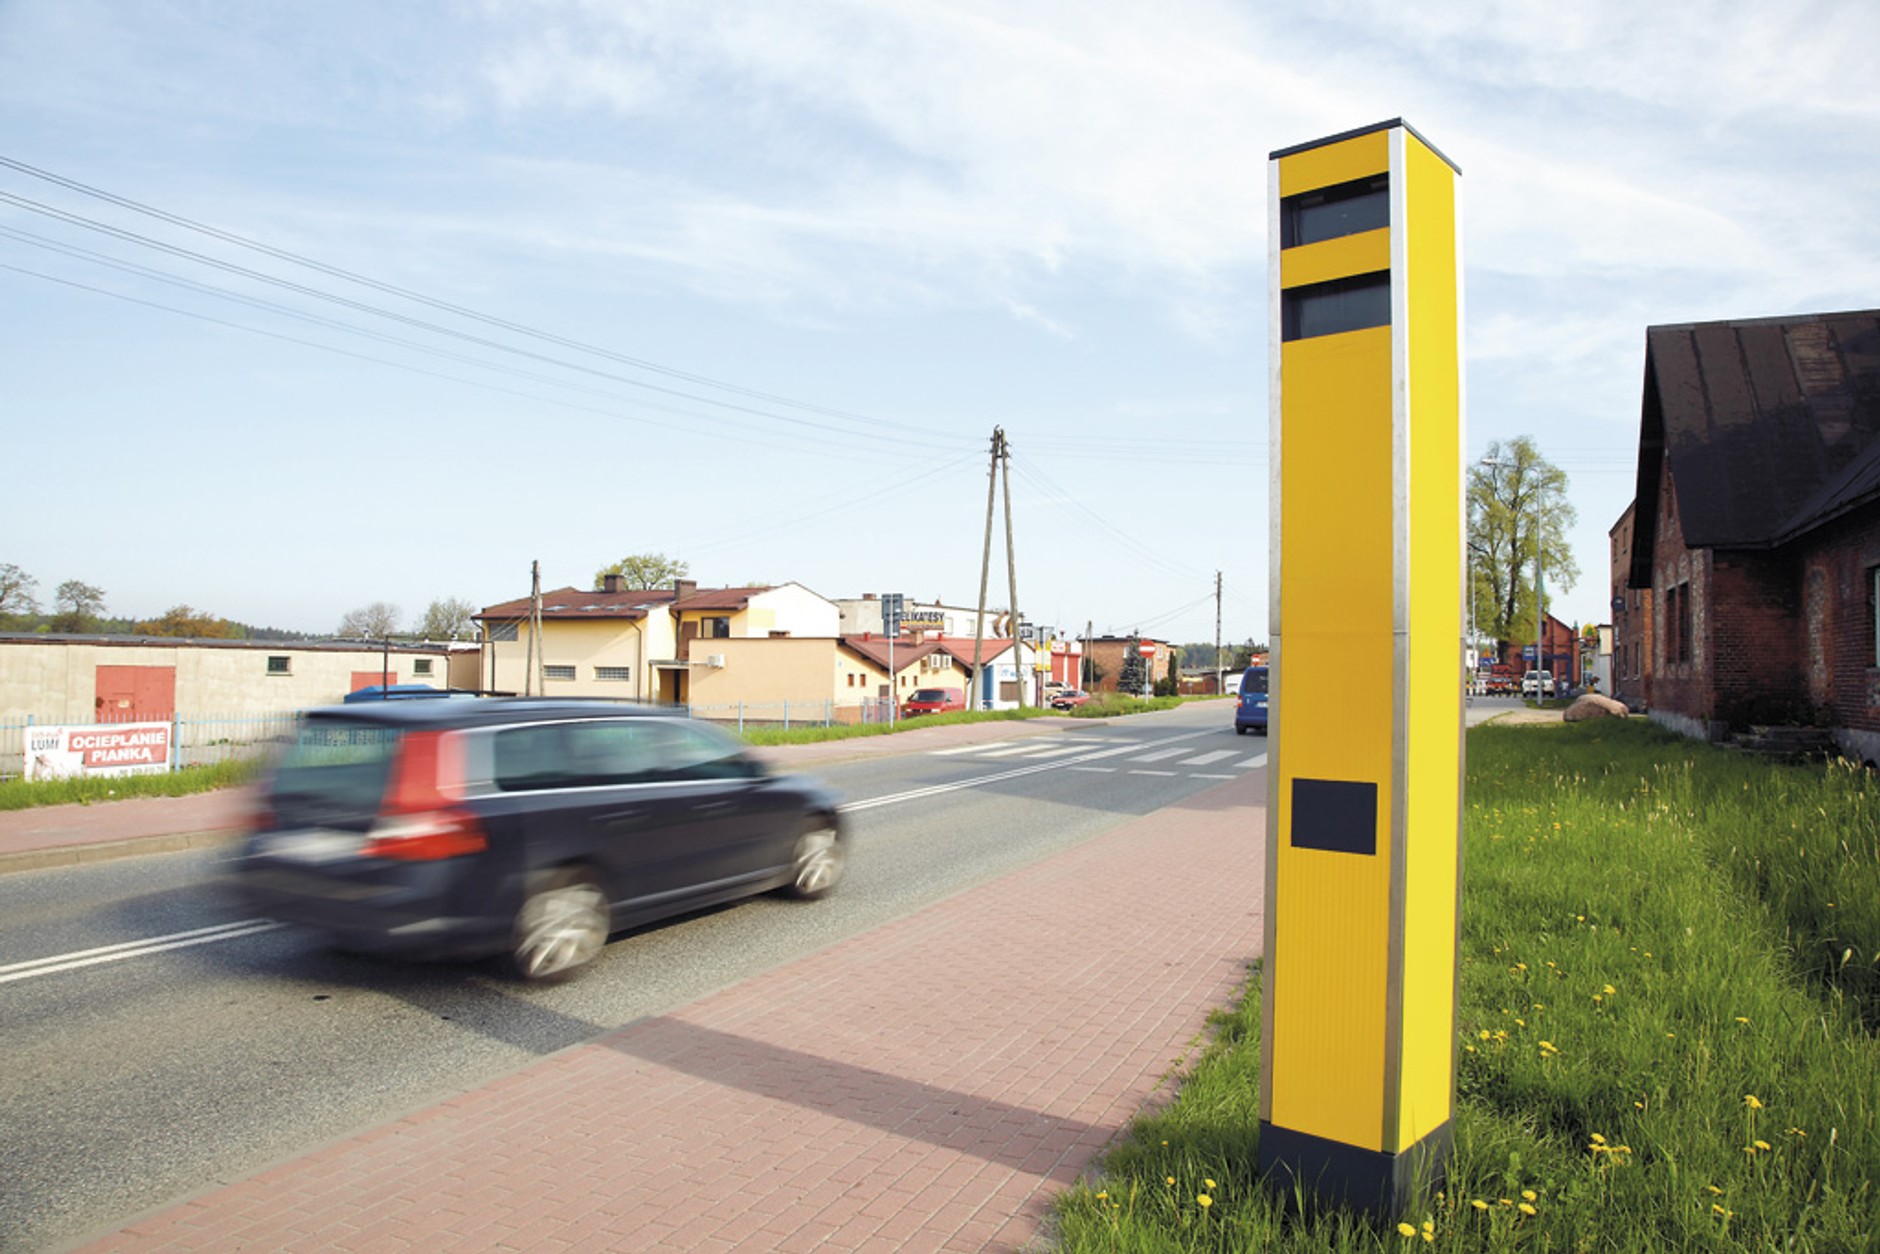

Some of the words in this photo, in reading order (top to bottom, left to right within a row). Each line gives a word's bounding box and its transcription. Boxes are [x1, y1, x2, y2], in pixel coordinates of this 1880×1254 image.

[901, 611, 945, 623] ELIKATESY
[72, 731, 166, 749] OCIEPLANIE
[91, 747, 152, 762] PIANKĄ
